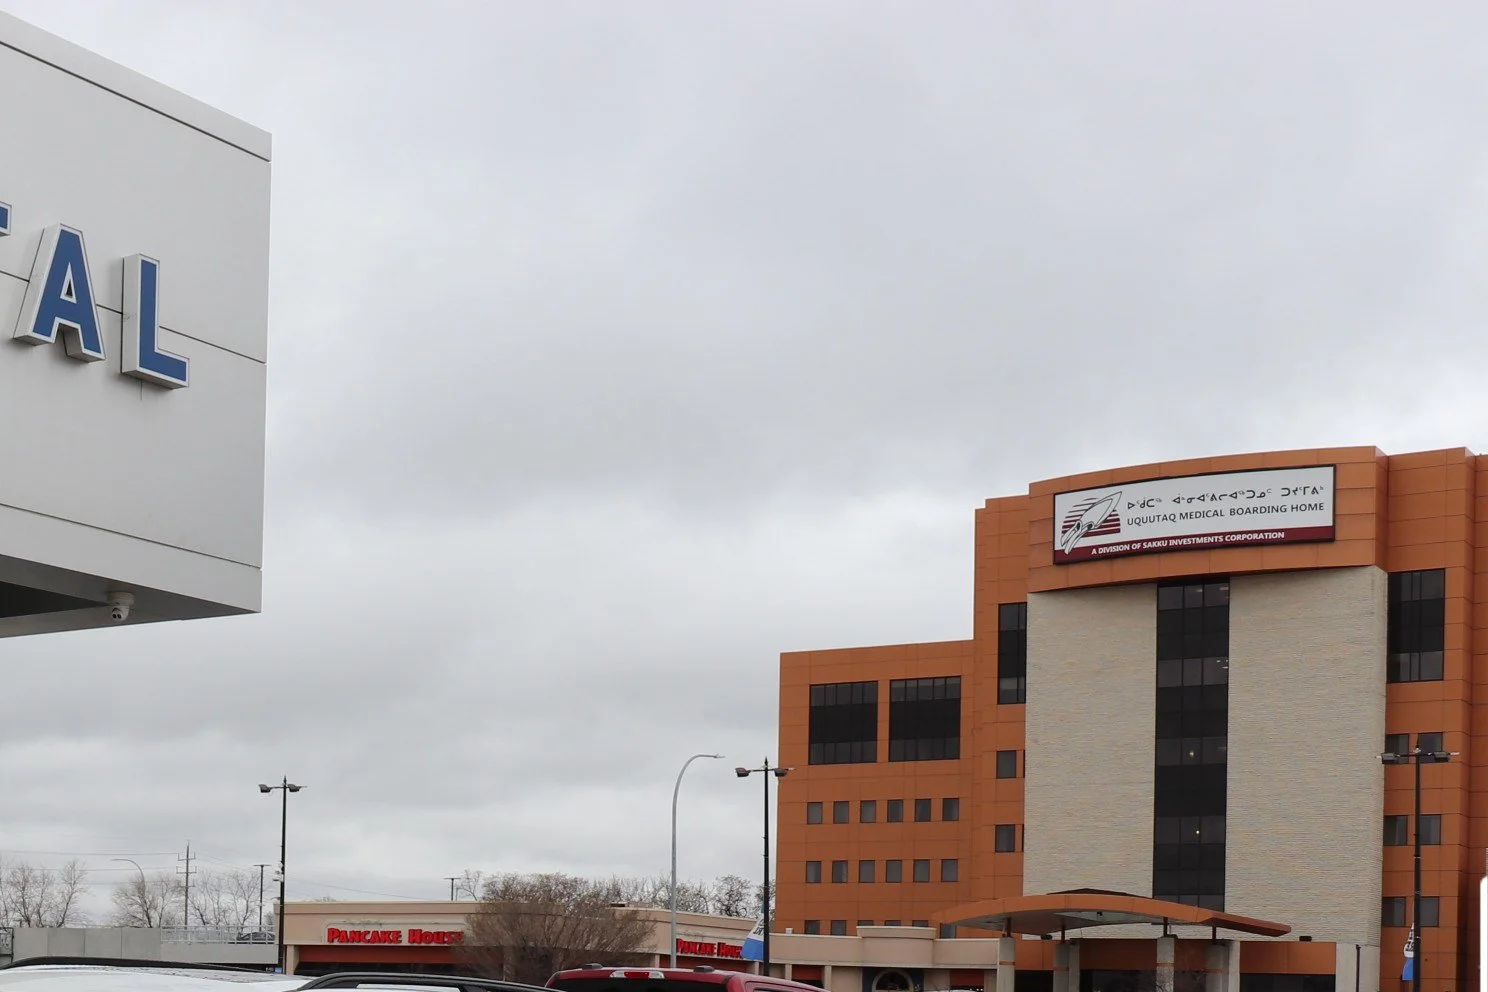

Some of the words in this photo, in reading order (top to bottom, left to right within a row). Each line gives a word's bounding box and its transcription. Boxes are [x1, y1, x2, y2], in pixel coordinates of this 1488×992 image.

[1126, 513, 1177, 526] UQUUTAQ
[1178, 508, 1225, 520] MEDICAL
[1229, 504, 1288, 517] BOARDING
[1290, 502, 1325, 513] HOME
[1091, 548, 1098, 556] A
[1098, 543, 1130, 555] DIVISION
[1131, 542, 1141, 551] OF
[1142, 539, 1168, 549] SAKKU
[1169, 534, 1223, 547] INVESTMENTS
[1224, 531, 1285, 543] CORPORATION
[327, 927, 403, 944] PANCAKE
